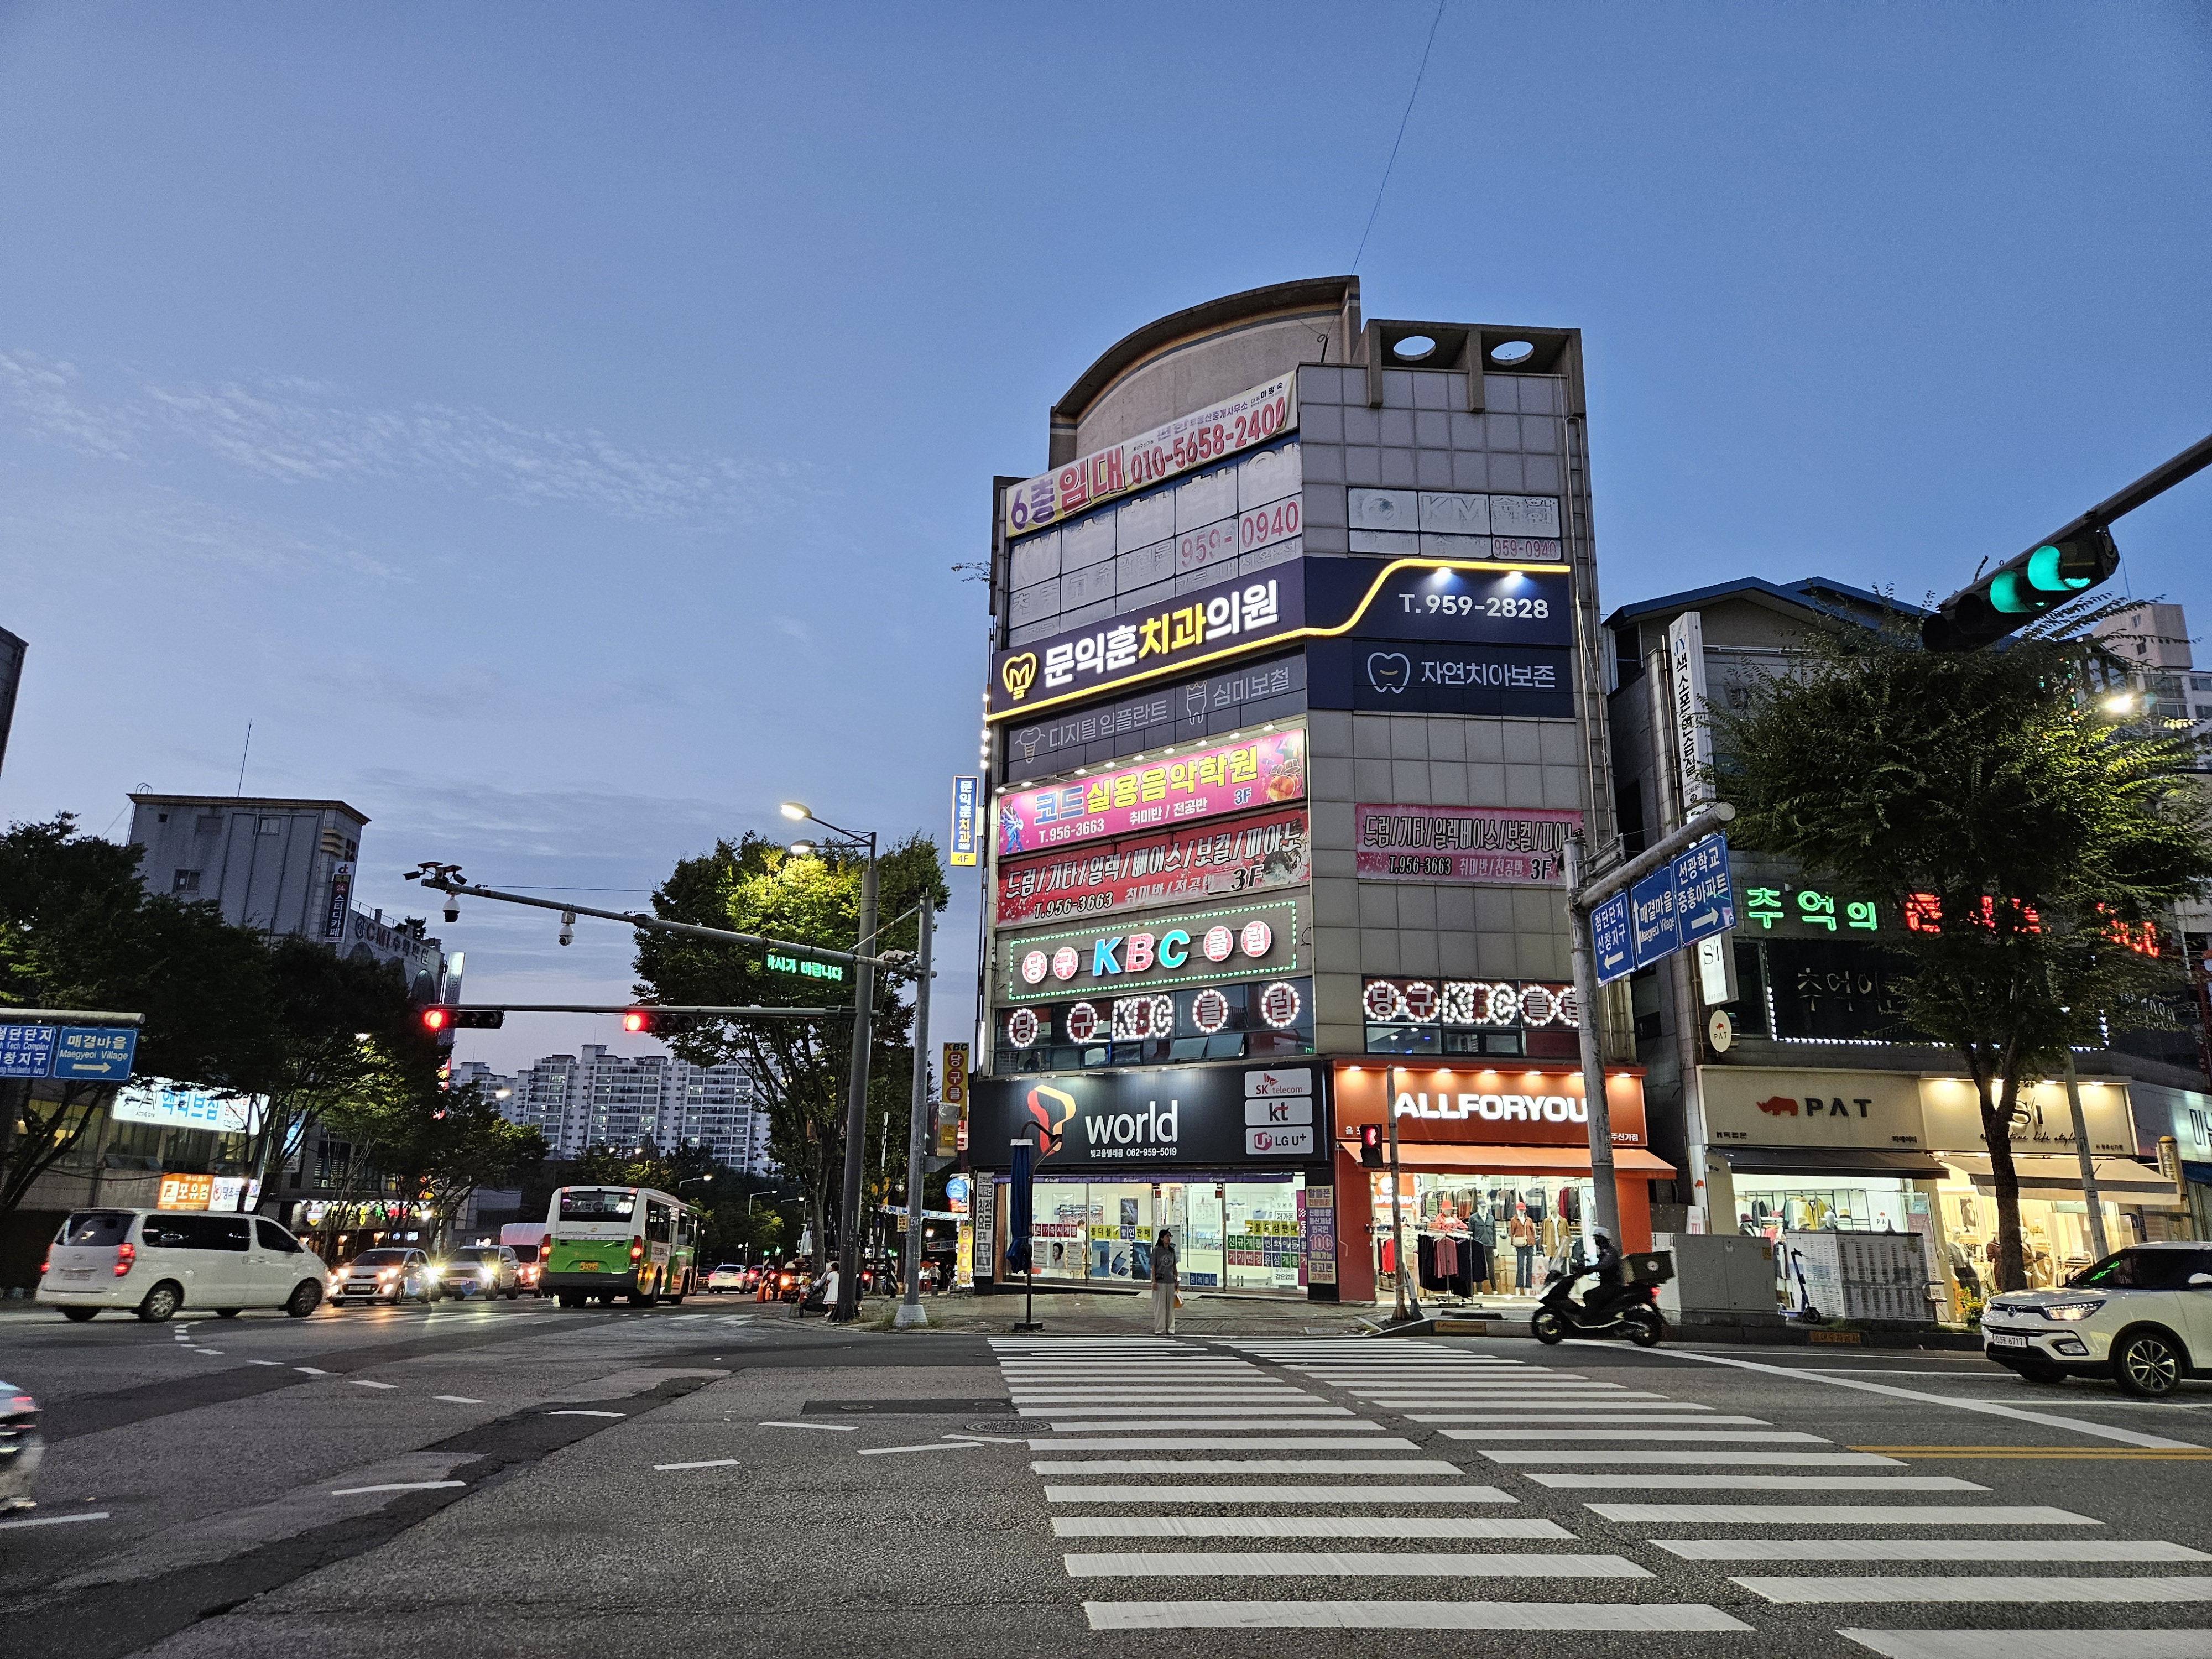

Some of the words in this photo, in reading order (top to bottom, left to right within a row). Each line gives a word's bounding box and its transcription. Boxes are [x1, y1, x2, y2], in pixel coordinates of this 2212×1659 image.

[1011, 478, 1056, 531] 6층
[1058, 445, 1127, 515] 임대
[1131, 397, 1285, 484] 010-5658-2400
[1181, 501, 1298, 568] 959-0940
[1494, 539, 1557, 559] 959-0940
[1044, 579, 1279, 688] 문익훈치과의원
[1421, 661, 1556, 688] 자연치아보존
[1213, 667, 1290, 708] 심미보철
[1234, 787, 1252, 805] 3F
[1129, 806, 1163, 826] 취미반
[1173, 797, 1208, 817] 전공반
[957, 854, 969, 863] 4F
[1678, 846, 1721, 885] 선광학교
[1230, 864, 1265, 893] 3F
[1530, 859, 1552, 880] 3F
[1677, 872, 1729, 915] 중흥아파트
[329, 894, 345, 937] 스터디카페
[1595, 898, 1625, 933] 첨단단지
[1639, 889, 1673, 924] 매결마을
[1747, 886, 1878, 932] 추억의
[1661, 915, 1676, 933] Village
[1597, 923, 1626, 955] 신창지구
[1092, 928, 1191, 977] KBC
[801, 961, 843, 982] 바랍니다
[1112, 994, 1174, 1041] KBC
[67, 1034, 127, 1050] 매결마을
[1714, 1031, 1728, 1040] PAT
[7, 1041, 20, 1050] Tech
[23, 1042, 49, 1051] Complex
[101, 1050, 128, 1062] Village
[944, 1043, 968, 1051] KBC
[0, 1051, 46, 1066] 창지구
[949, 1053, 963, 1100] 당구클
[1255, 1084, 1269, 1095] SK
[1272, 1086, 1303, 1094] telecom
[1269, 1102, 1289, 1121] kt
[1395, 1093, 1589, 1123] ALLFORYOU
[1805, 1098, 1874, 1118] PAT
[1086, 1099, 1179, 1145] world
[1275, 1136, 1289, 1146] LG
[2033, 1131, 2051, 1144] life
[1126, 1147, 1177, 1157] 062-959-5019
[1308, 1188, 1331, 1198] 알뜰폰
[615, 1202, 633, 1214] 40
[978, 1199, 992, 1214] 최적
[1276, 1212, 1294, 1221] 저가폰
[978, 1214, 992, 1230] 요금
[977, 1231, 987, 1241] 설계
[1311, 1262, 1333, 1273] 중고폰
[2007, 1337, 2023, 1347] 6717
